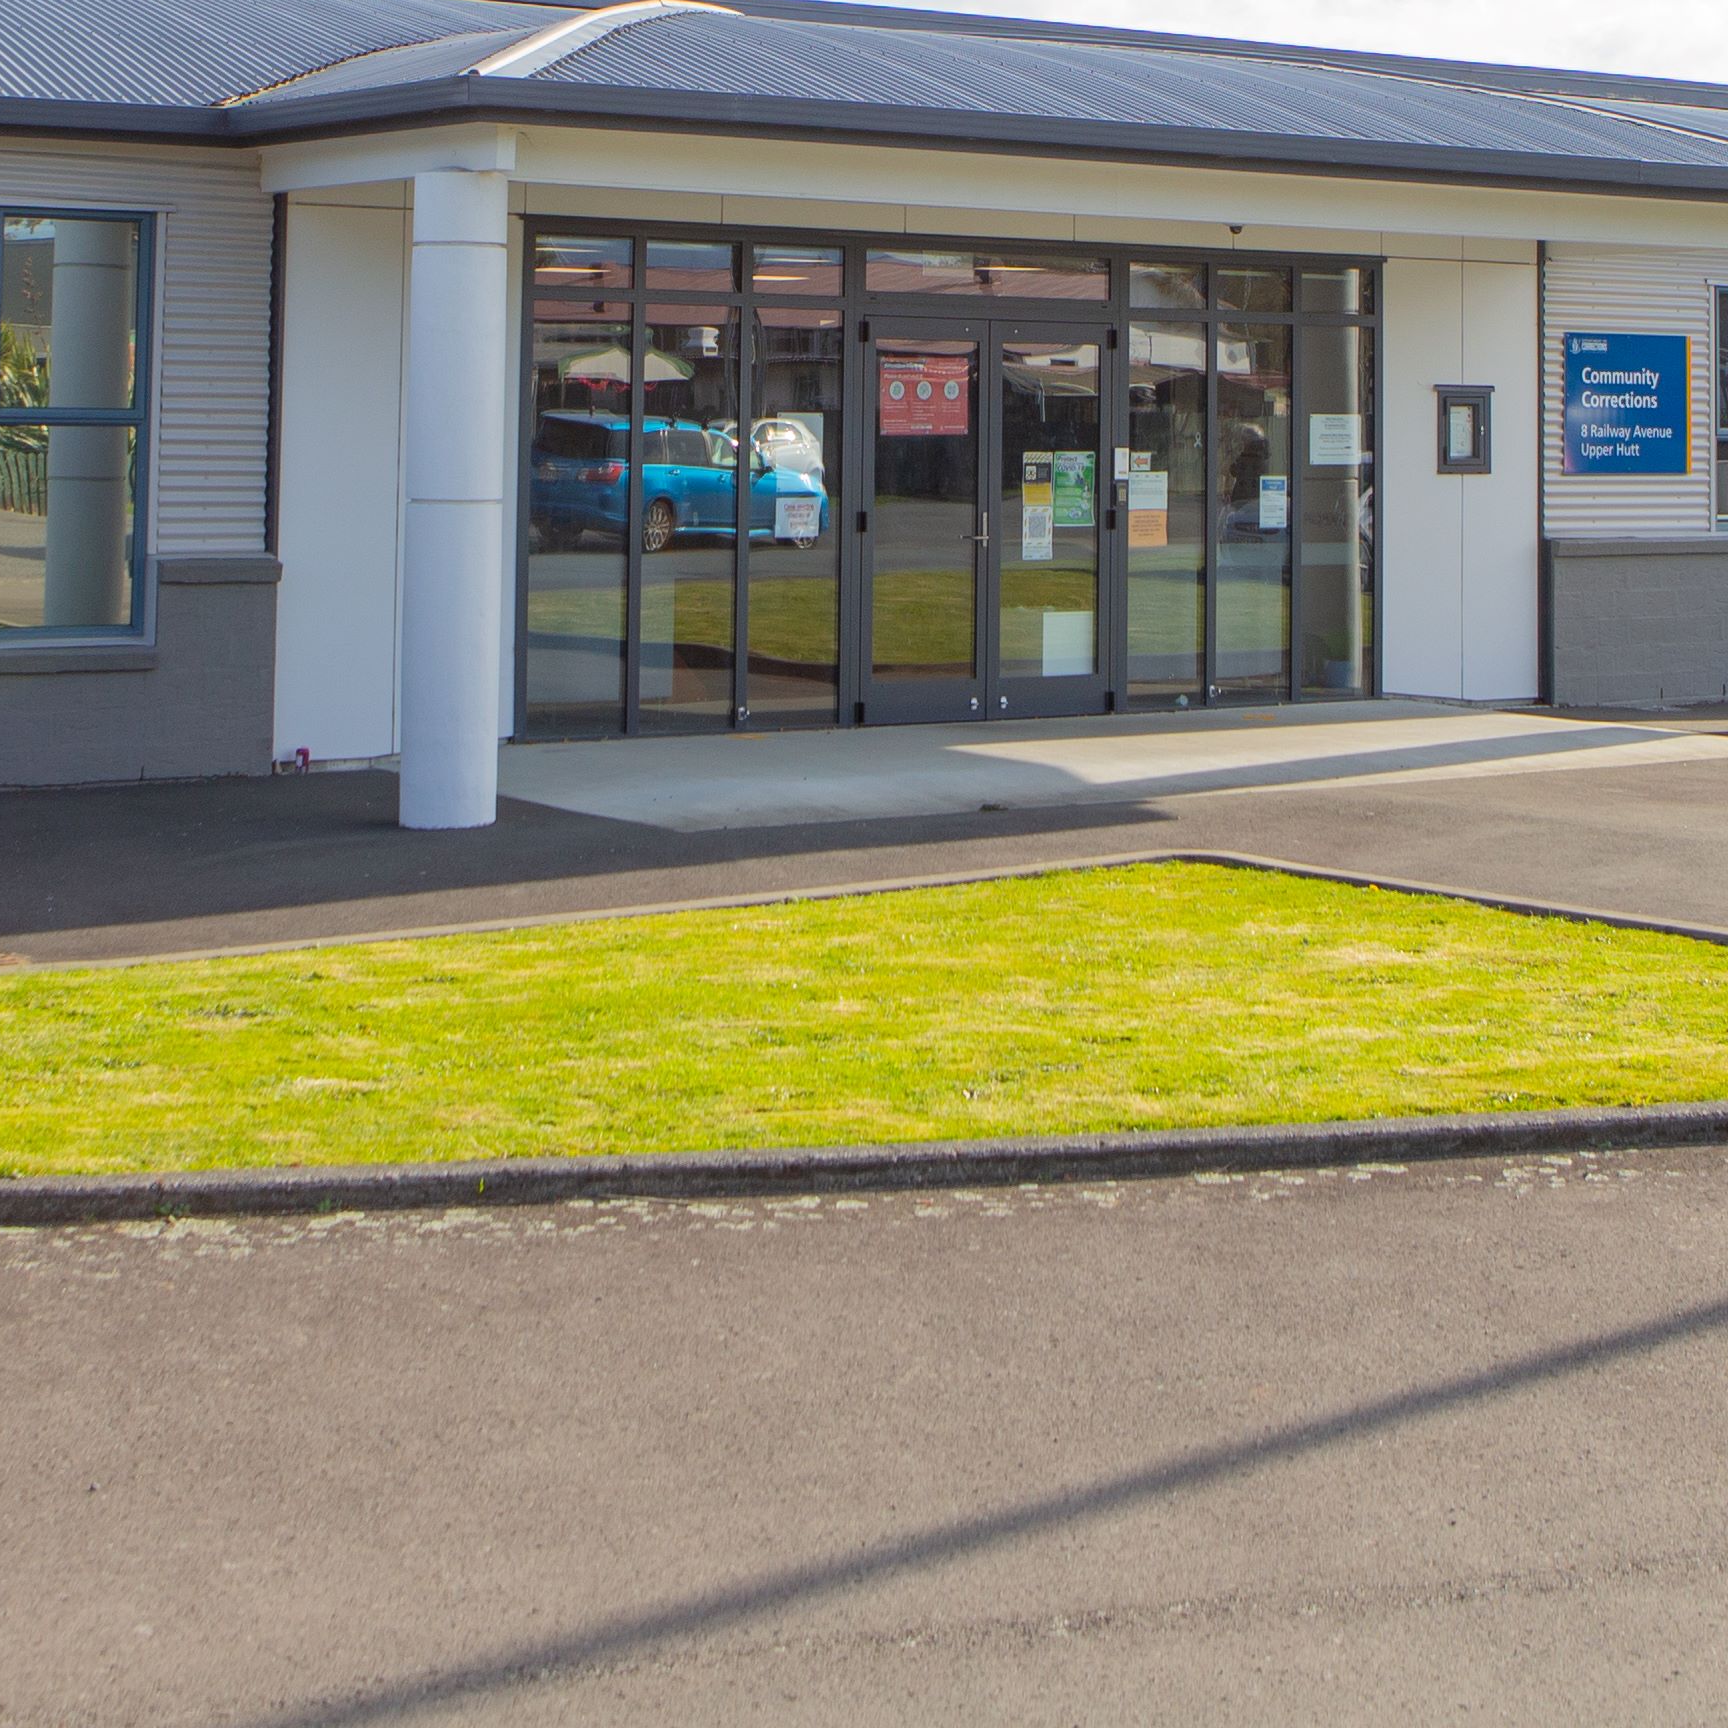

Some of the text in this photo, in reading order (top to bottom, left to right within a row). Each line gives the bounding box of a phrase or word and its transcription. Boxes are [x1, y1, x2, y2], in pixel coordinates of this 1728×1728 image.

[1581, 367, 1660, 389] Community
[1581, 391, 1658, 409] Corrections
[1580, 424, 1672, 441] 8 Railway Avenue
[1581, 443, 1640, 459] Upper Hutt
